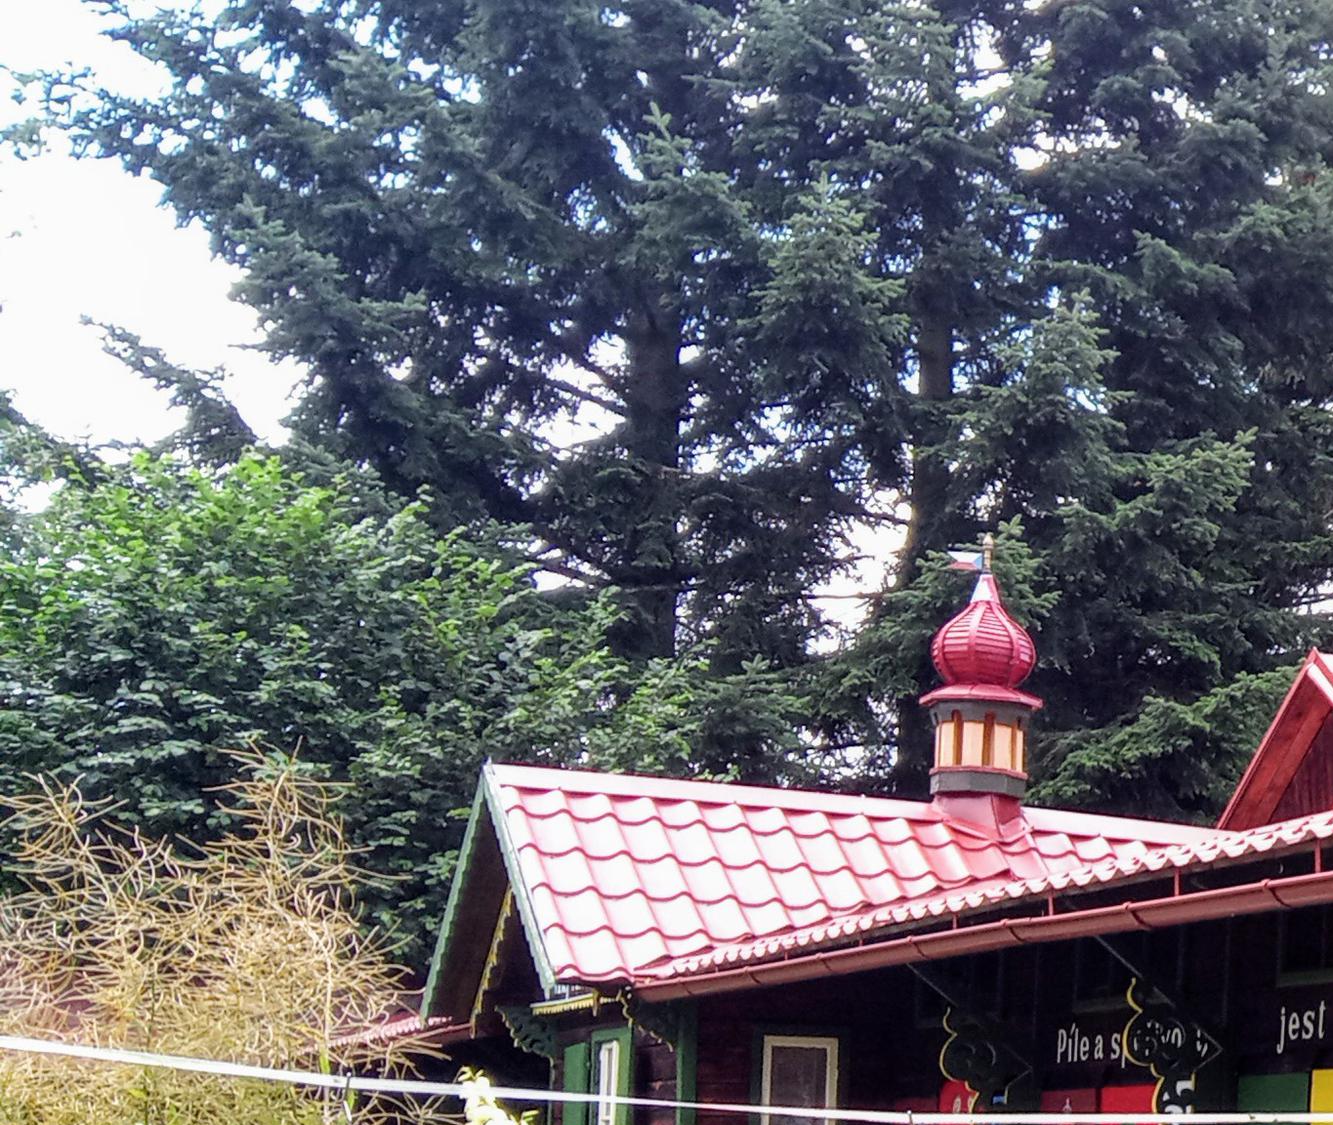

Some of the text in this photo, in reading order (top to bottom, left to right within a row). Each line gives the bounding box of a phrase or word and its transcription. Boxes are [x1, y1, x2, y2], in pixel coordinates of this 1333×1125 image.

[1056, 1021, 1091, 1064] Píle
[1093, 1033, 1104, 1061] a
[1276, 1000, 1327, 1054] jest
